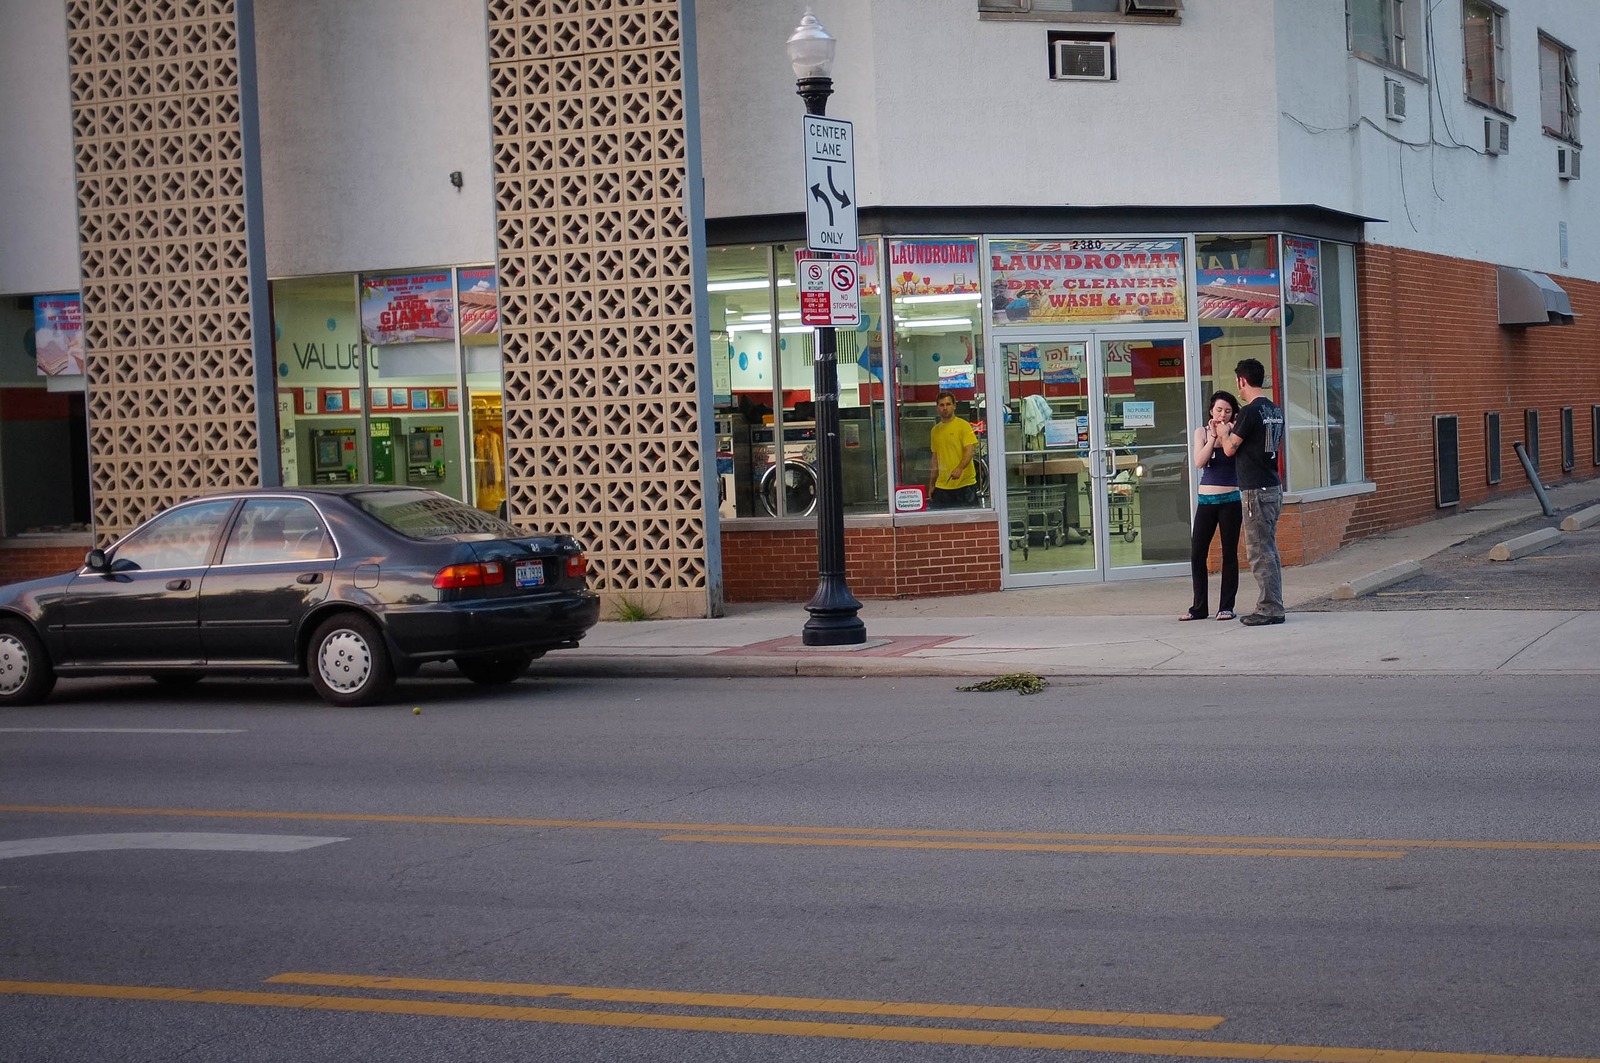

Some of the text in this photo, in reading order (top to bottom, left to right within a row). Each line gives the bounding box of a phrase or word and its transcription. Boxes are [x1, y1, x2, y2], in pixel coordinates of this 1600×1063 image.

[810, 123, 847, 141] CENTER
[816, 141, 842, 157] LANE
[820, 231, 844, 245] ONLY
[1072, 240, 1102, 250] 2380
[892, 244, 976, 265] LAUNDROMAT
[992, 253, 1180, 271] LAUNDROMAT
[1007, 278, 1178, 291] DRY CLEANERS
[388, 300, 427, 311] LARGE
[833, 302, 857, 310] STOPPING
[1049, 292, 1175, 308] WASH & FOLD
[380, 308, 435, 325] GIANT
